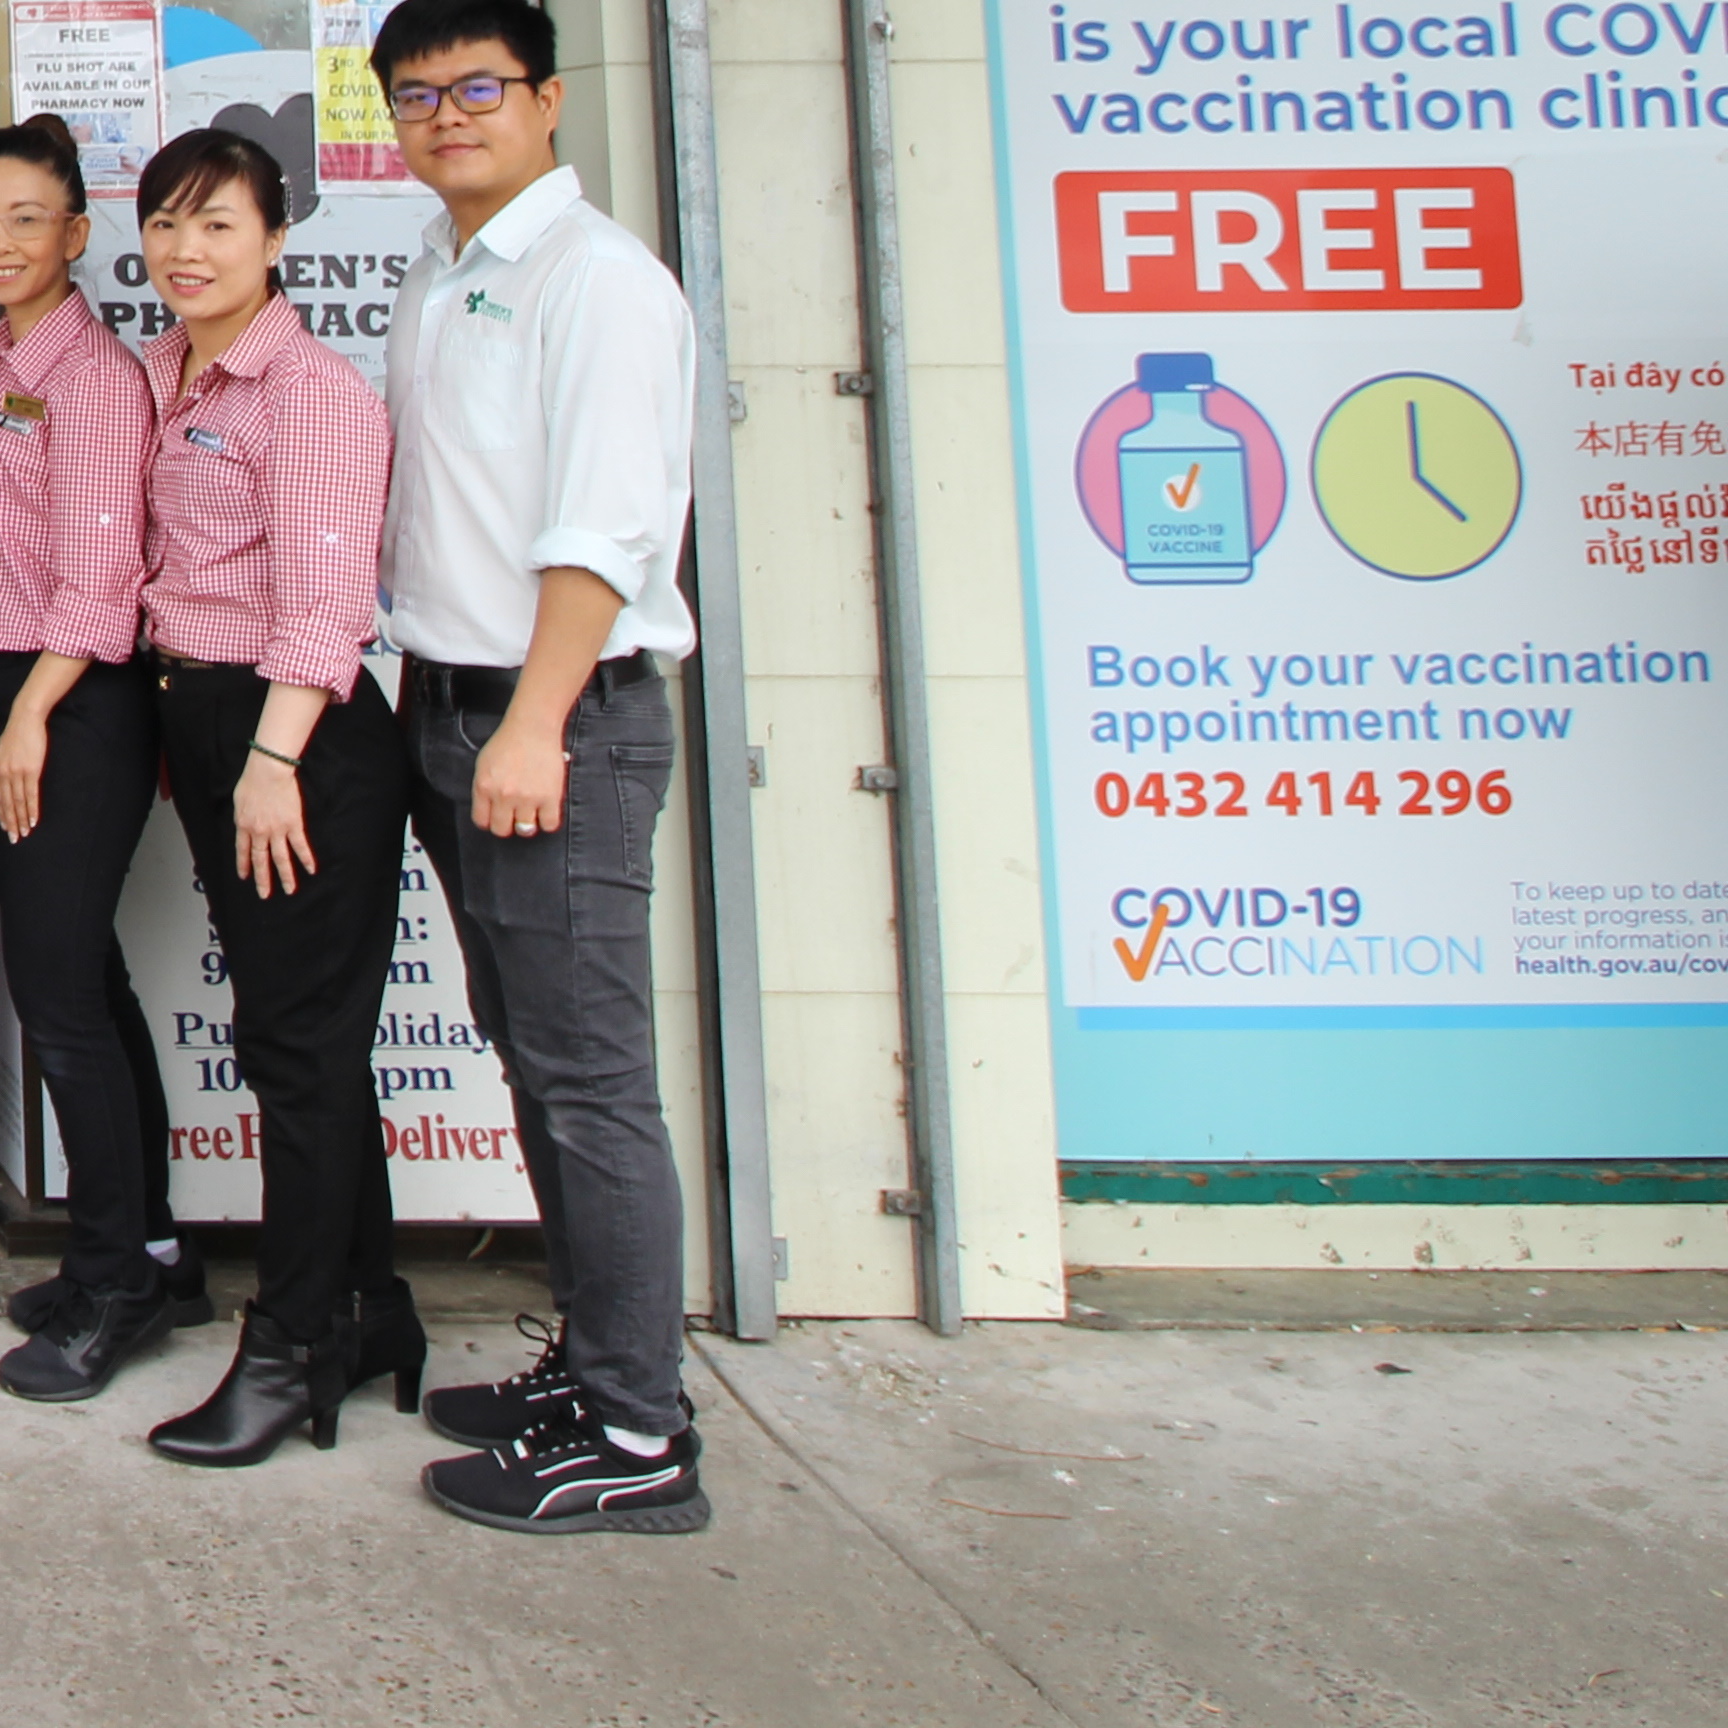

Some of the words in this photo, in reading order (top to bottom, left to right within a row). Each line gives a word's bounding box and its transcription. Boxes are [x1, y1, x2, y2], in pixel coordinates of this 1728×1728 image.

[58, 29, 110, 43] FREE
[1049, 4, 1111, 63] is
[1131, 15, 1311, 75] your
[1335, 1, 1520, 61] local
[36, 61, 62, 72] FLU
[67, 61, 104, 72] SHOT
[108, 61, 136, 72] ARE
[22, 79, 99, 91] AVAILABLE
[122, 79, 151, 91] OUR
[329, 84, 379, 99] COVID
[31, 98, 107, 110] PHARMACY
[113, 98, 146, 110] NOW
[325, 108, 367, 122] NOW
[1052, 73, 1513, 135] vaccination
[1095, 187, 1484, 295] FREE
[1568, 361, 1616, 395] Tại
[1624, 360, 1682, 393] đây
[1690, 359, 1725, 387] có
[1146, 522, 1225, 538] COVID-19
[1147, 539, 1224, 555] VACCINE
[1085, 643, 1231, 689] Book
[1247, 649, 1374, 699] your
[1389, 639, 1712, 688] vaccination
[1088, 697, 1440, 754] appointment
[1457, 702, 1573, 742] now
[1094, 771, 1249, 819] 0432
[1264, 770, 1382, 818] 414
[1397, 768, 1515, 817] 296
[1110, 886, 1362, 928] COVID-19
[1511, 881, 1540, 901] To
[1547, 881, 1603, 907] keep
[1610, 885, 1643, 907] up
[1651, 882, 1676, 900] to
[1511, 905, 1576, 926] latest
[1586, 907, 1695, 932] progress,
[1512, 932, 1568, 954] your
[1574, 928, 1709, 951] information
